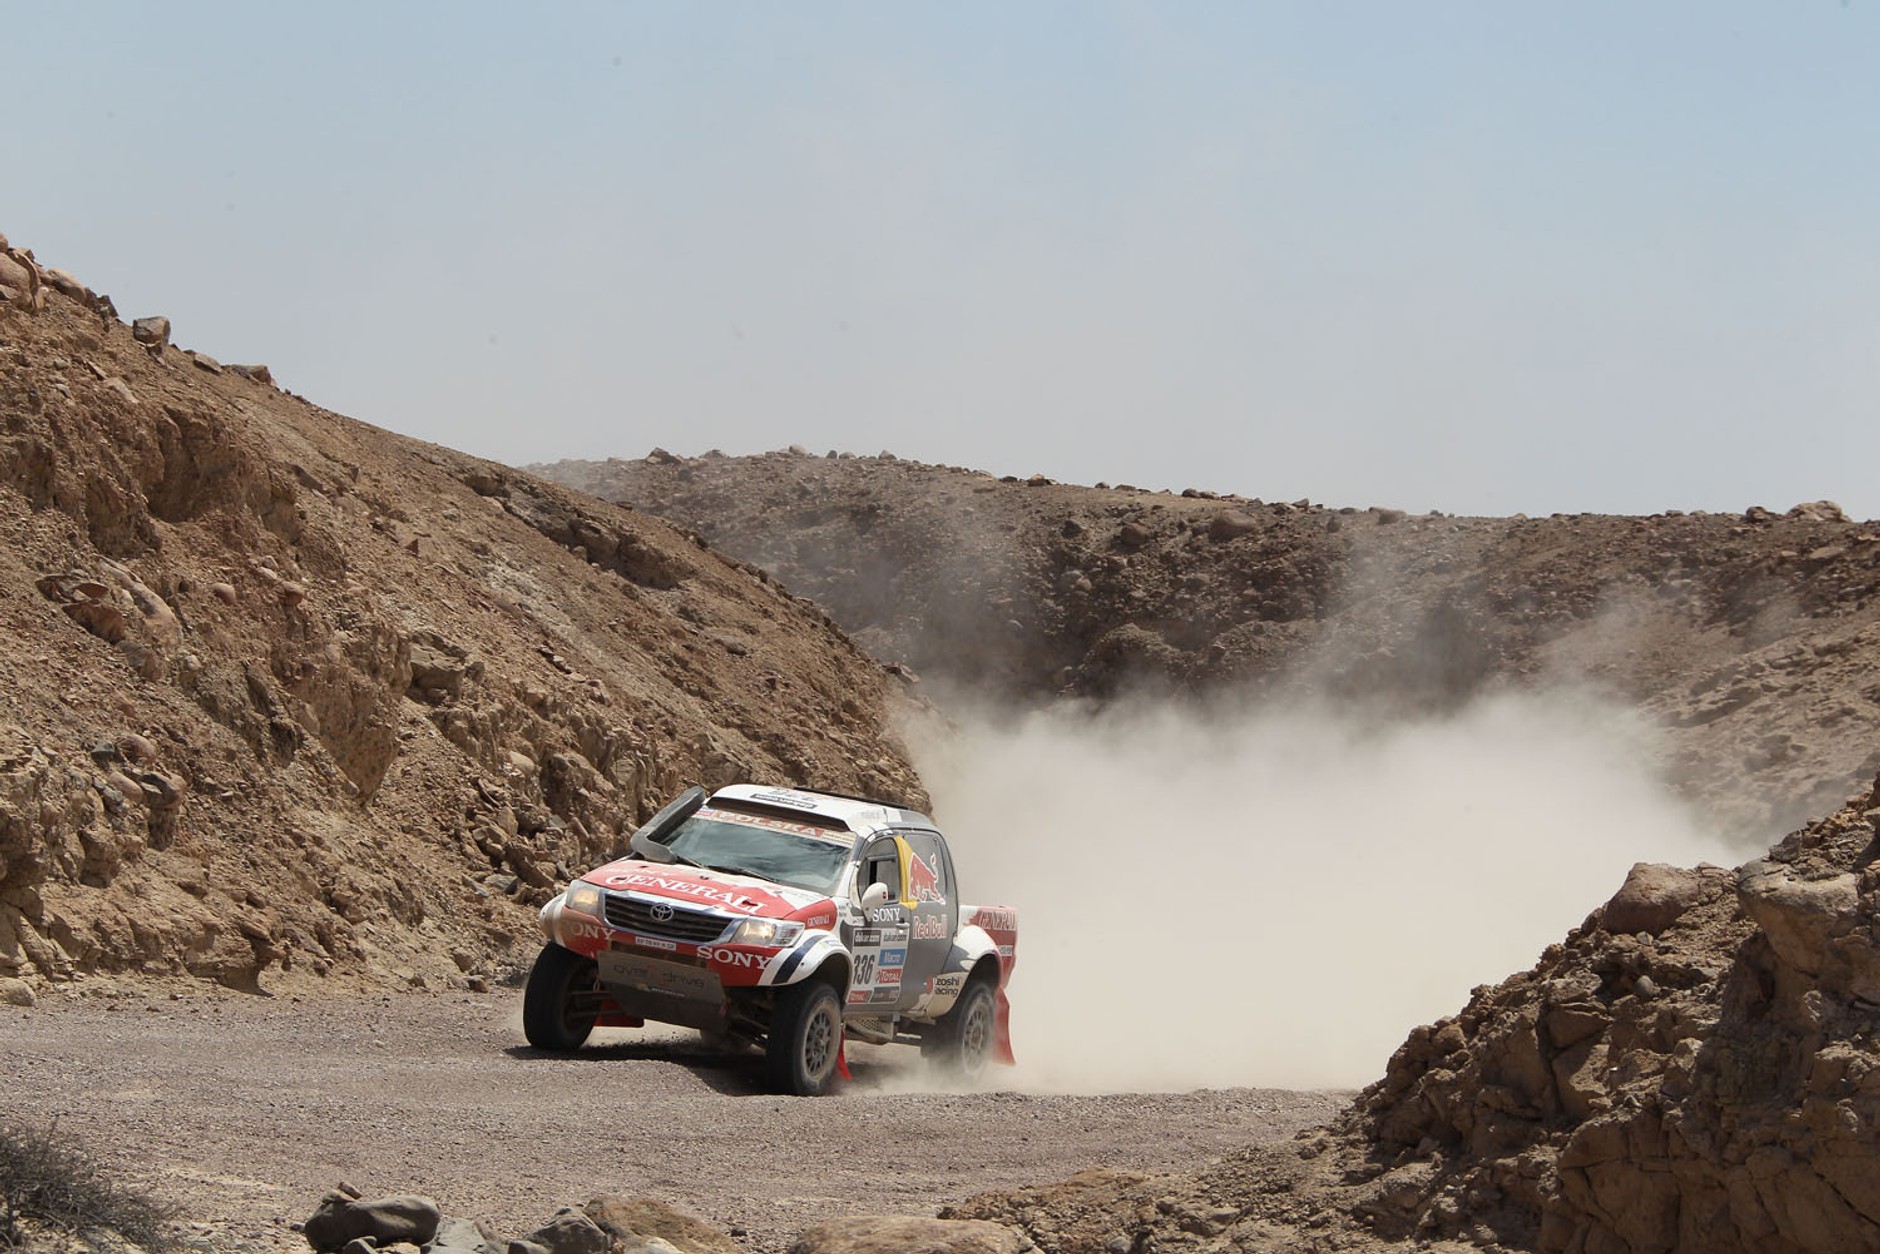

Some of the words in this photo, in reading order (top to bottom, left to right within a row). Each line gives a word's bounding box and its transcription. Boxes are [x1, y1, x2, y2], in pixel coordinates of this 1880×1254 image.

[604, 873, 768, 914] GENERALI
[872, 907, 900, 922] SONY
[565, 921, 616, 940] ONY
[696, 945, 775, 970] SONY
[852, 954, 875, 985] 336
